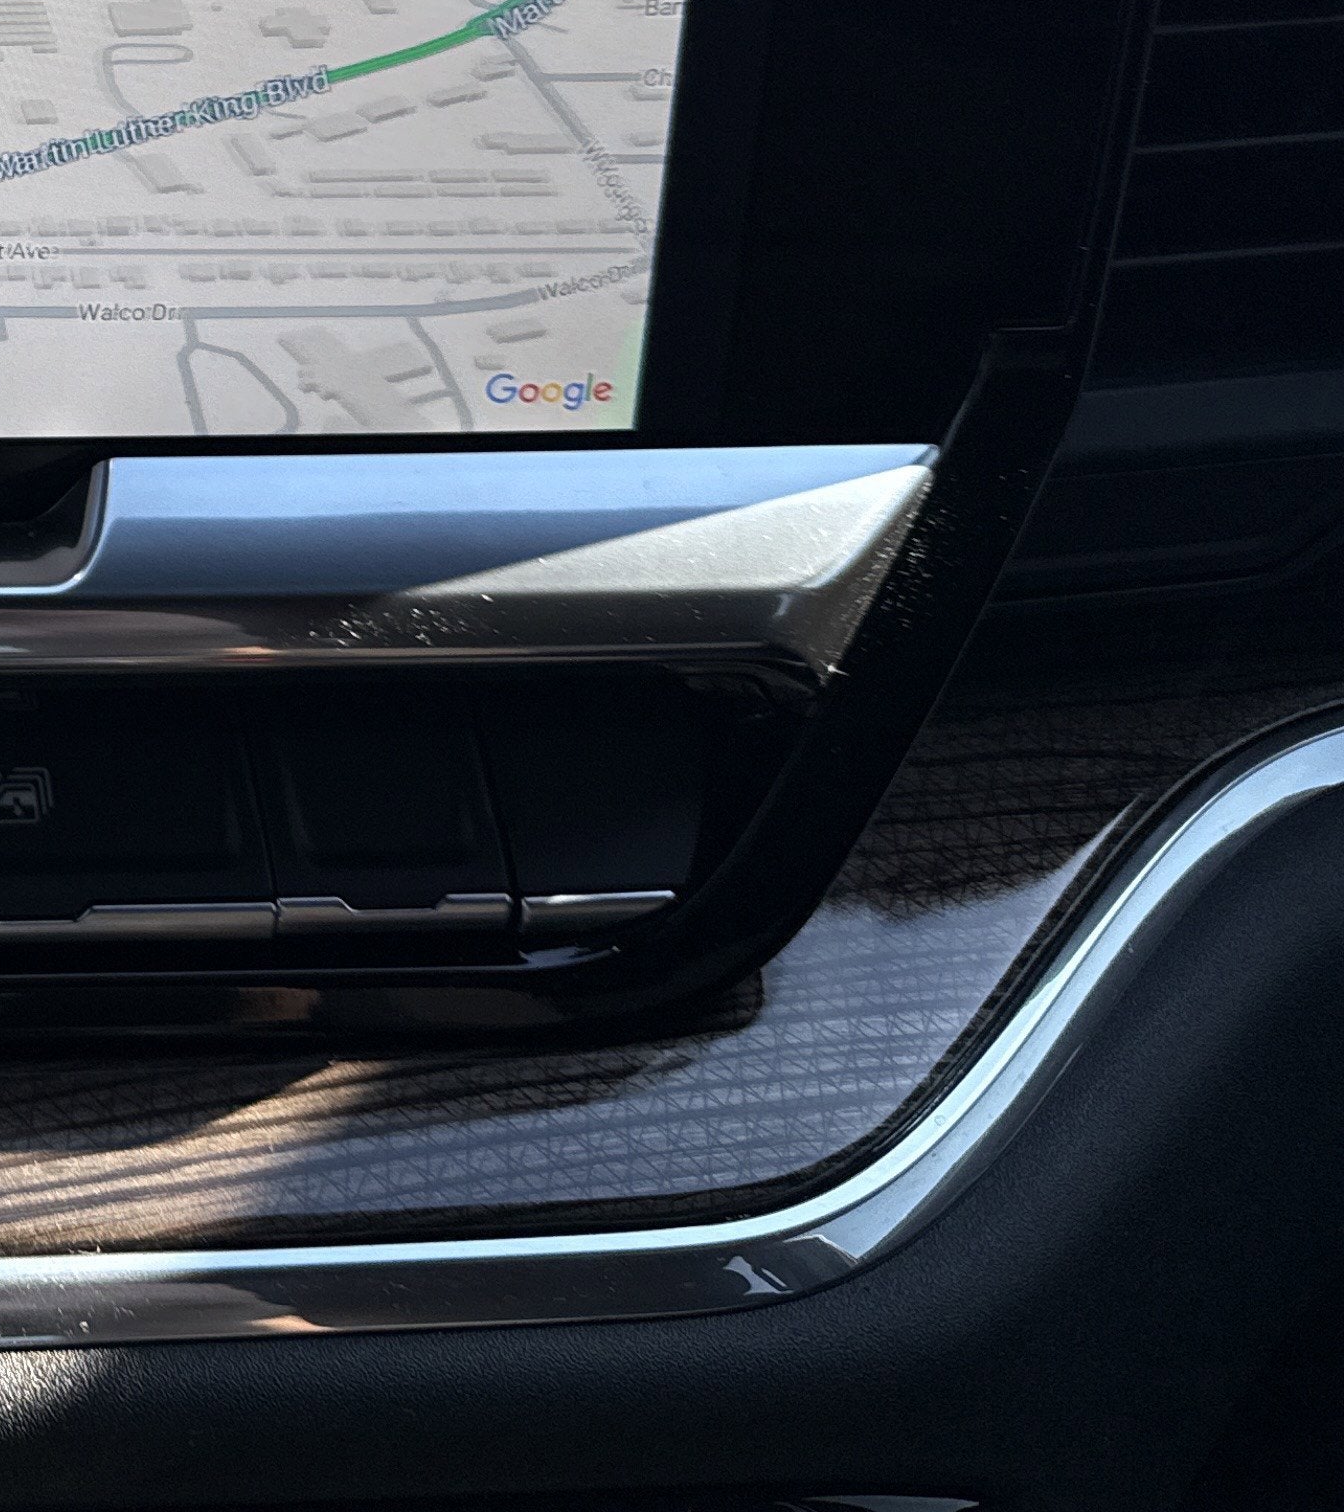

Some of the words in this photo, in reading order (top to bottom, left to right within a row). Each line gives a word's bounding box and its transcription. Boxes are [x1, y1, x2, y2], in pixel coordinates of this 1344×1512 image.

[261, 64, 331, 108] Blvd
[12, 241, 55, 260] Ave
[78, 301, 142, 323] Walco
[148, 301, 182, 322] Dr
[485, 371, 614, 413] Google
